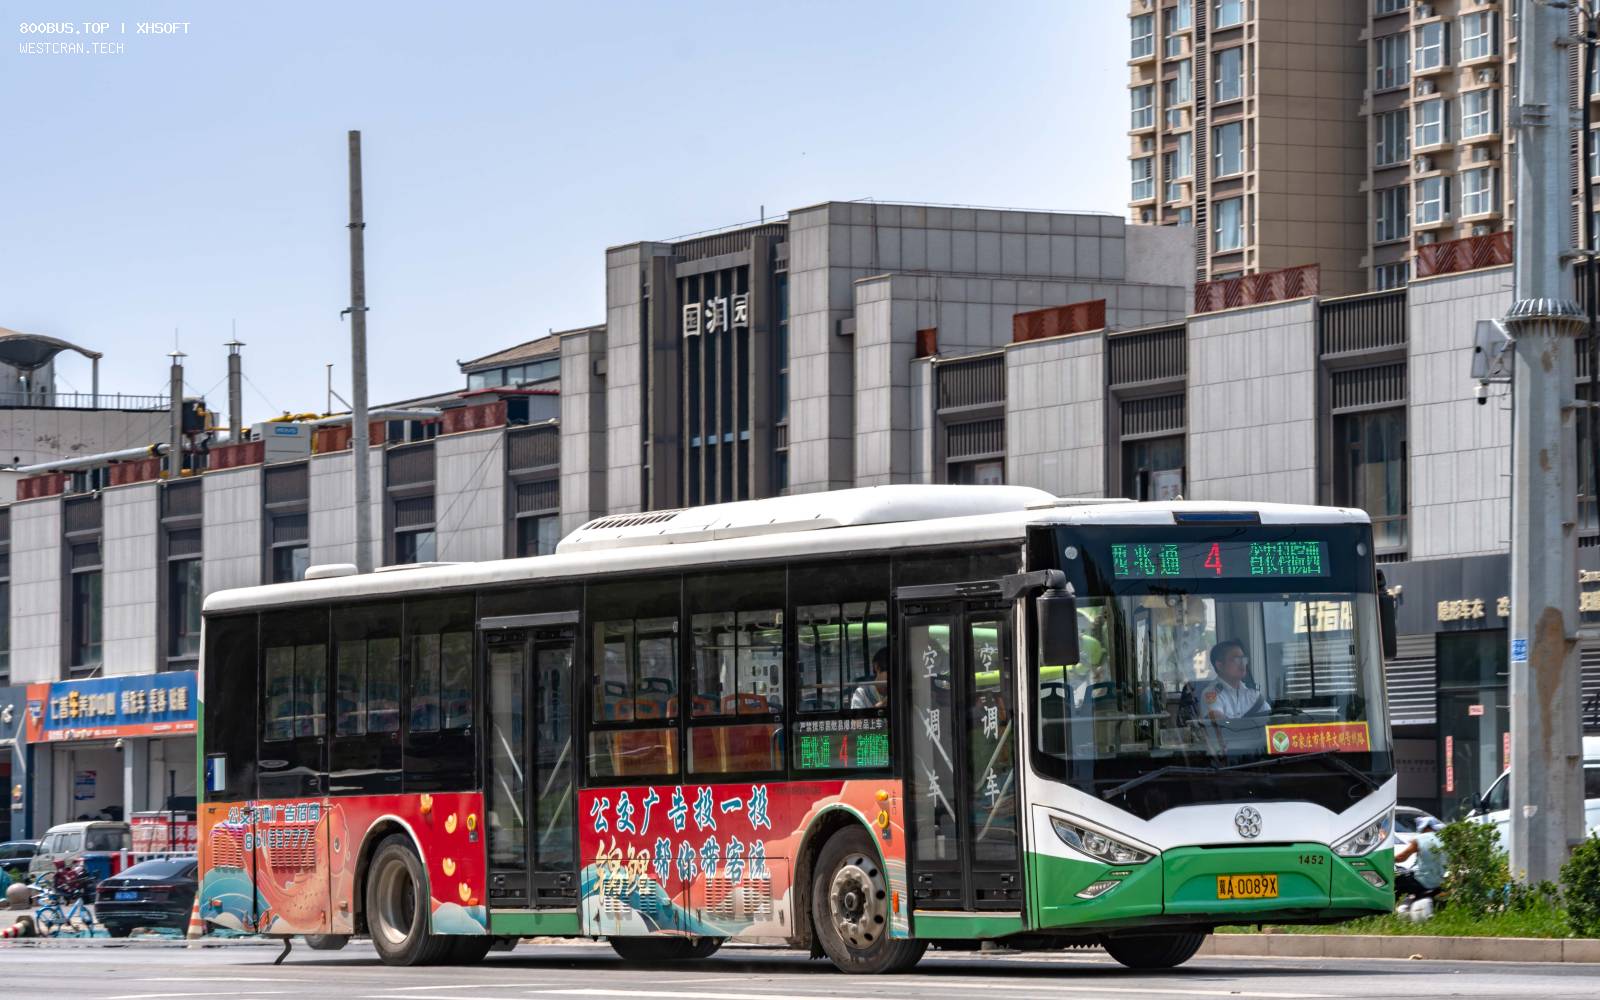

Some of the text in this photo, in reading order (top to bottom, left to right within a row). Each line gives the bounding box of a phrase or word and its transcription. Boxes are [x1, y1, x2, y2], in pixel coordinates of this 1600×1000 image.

[1203, 542, 1223, 575] 4
[979, 642, 1000, 808] 空调车
[839, 734, 848, 768] 4
[589, 783, 772, 836] 公交广告投一投
[1298, 855, 1324, 866] 1452
